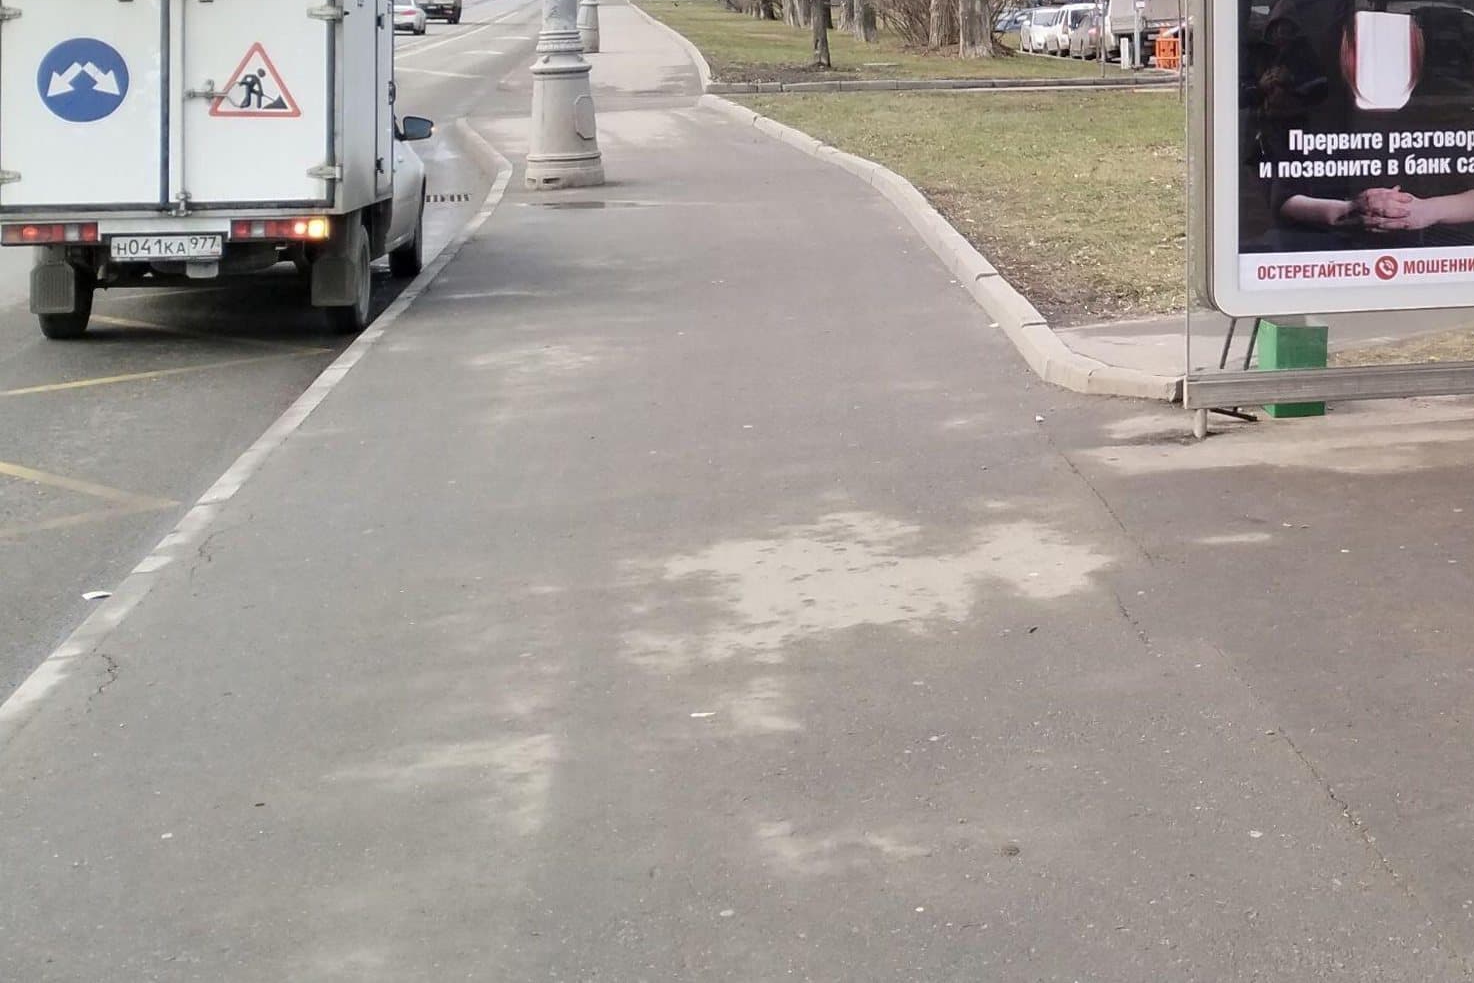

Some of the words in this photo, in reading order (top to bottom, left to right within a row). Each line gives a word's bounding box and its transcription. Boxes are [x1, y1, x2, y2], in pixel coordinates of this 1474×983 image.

[1288, 128, 1384, 155] Прервите
[1259, 161, 1273, 179] и
[1278, 158, 1383, 178] позвоните
[1387, 158, 1400, 176] в
[1404, 153, 1452, 175] банк
[190, 236, 218, 250] 977
[1257, 260, 1371, 281] ОСТЕРЕГАЙТЕСЬ
